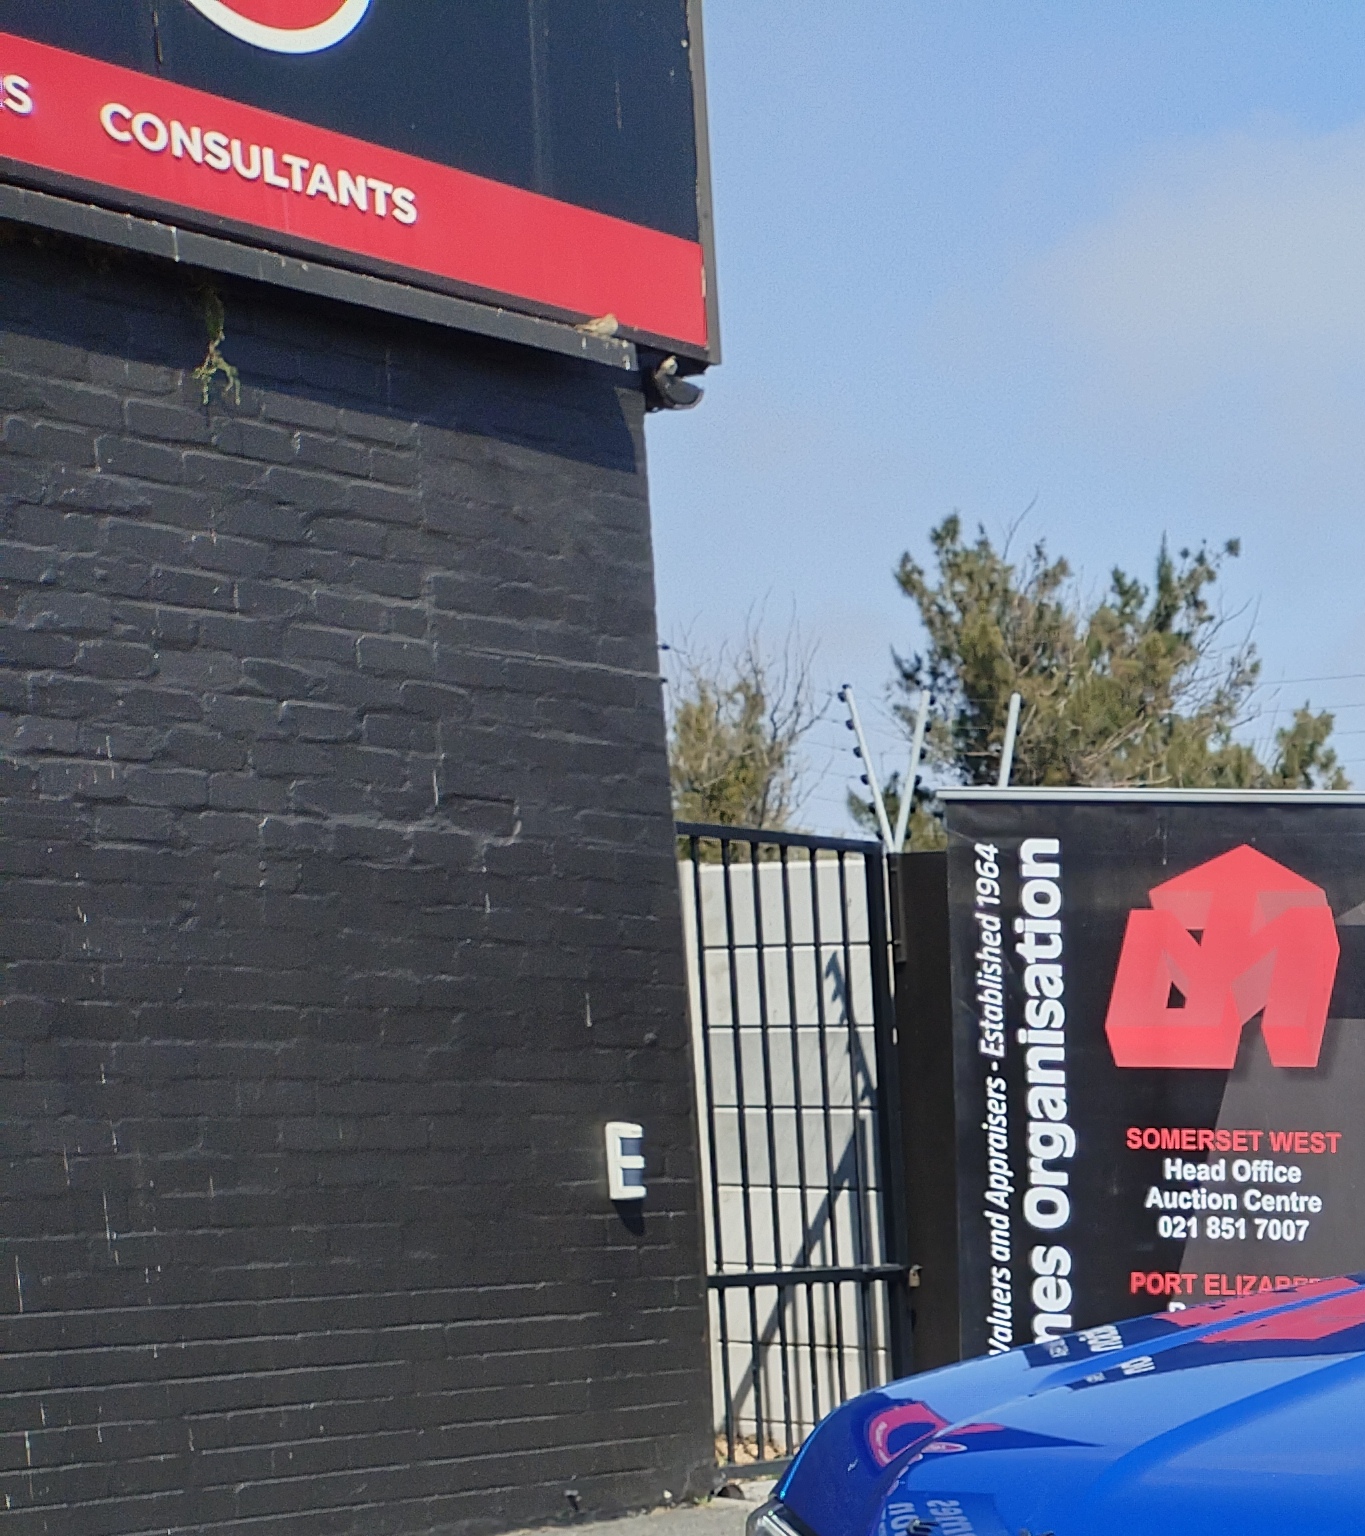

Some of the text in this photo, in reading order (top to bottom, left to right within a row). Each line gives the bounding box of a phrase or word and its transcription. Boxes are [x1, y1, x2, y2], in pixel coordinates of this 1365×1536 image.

[100, 101, 417, 224] CONSULTANTS
[974, 842, 1000, 906] 1964
[975, 912, 1005, 1059] Established
[981, 1075, 1015, 1210] Appraisers
[1126, 1126, 1342, 1154] SOMERSET WEST
[1163, 1157, 1302, 1184] Head Office
[1144, 1186, 1323, 1214] Auction Centre
[983, 1210, 1011, 1262] and
[1157, 1215, 1310, 1242] 021 851 7007
[1130, 1271, 1321, 1297] PORT ELIZAB
[986, 1265, 1013, 1356] Valuers
